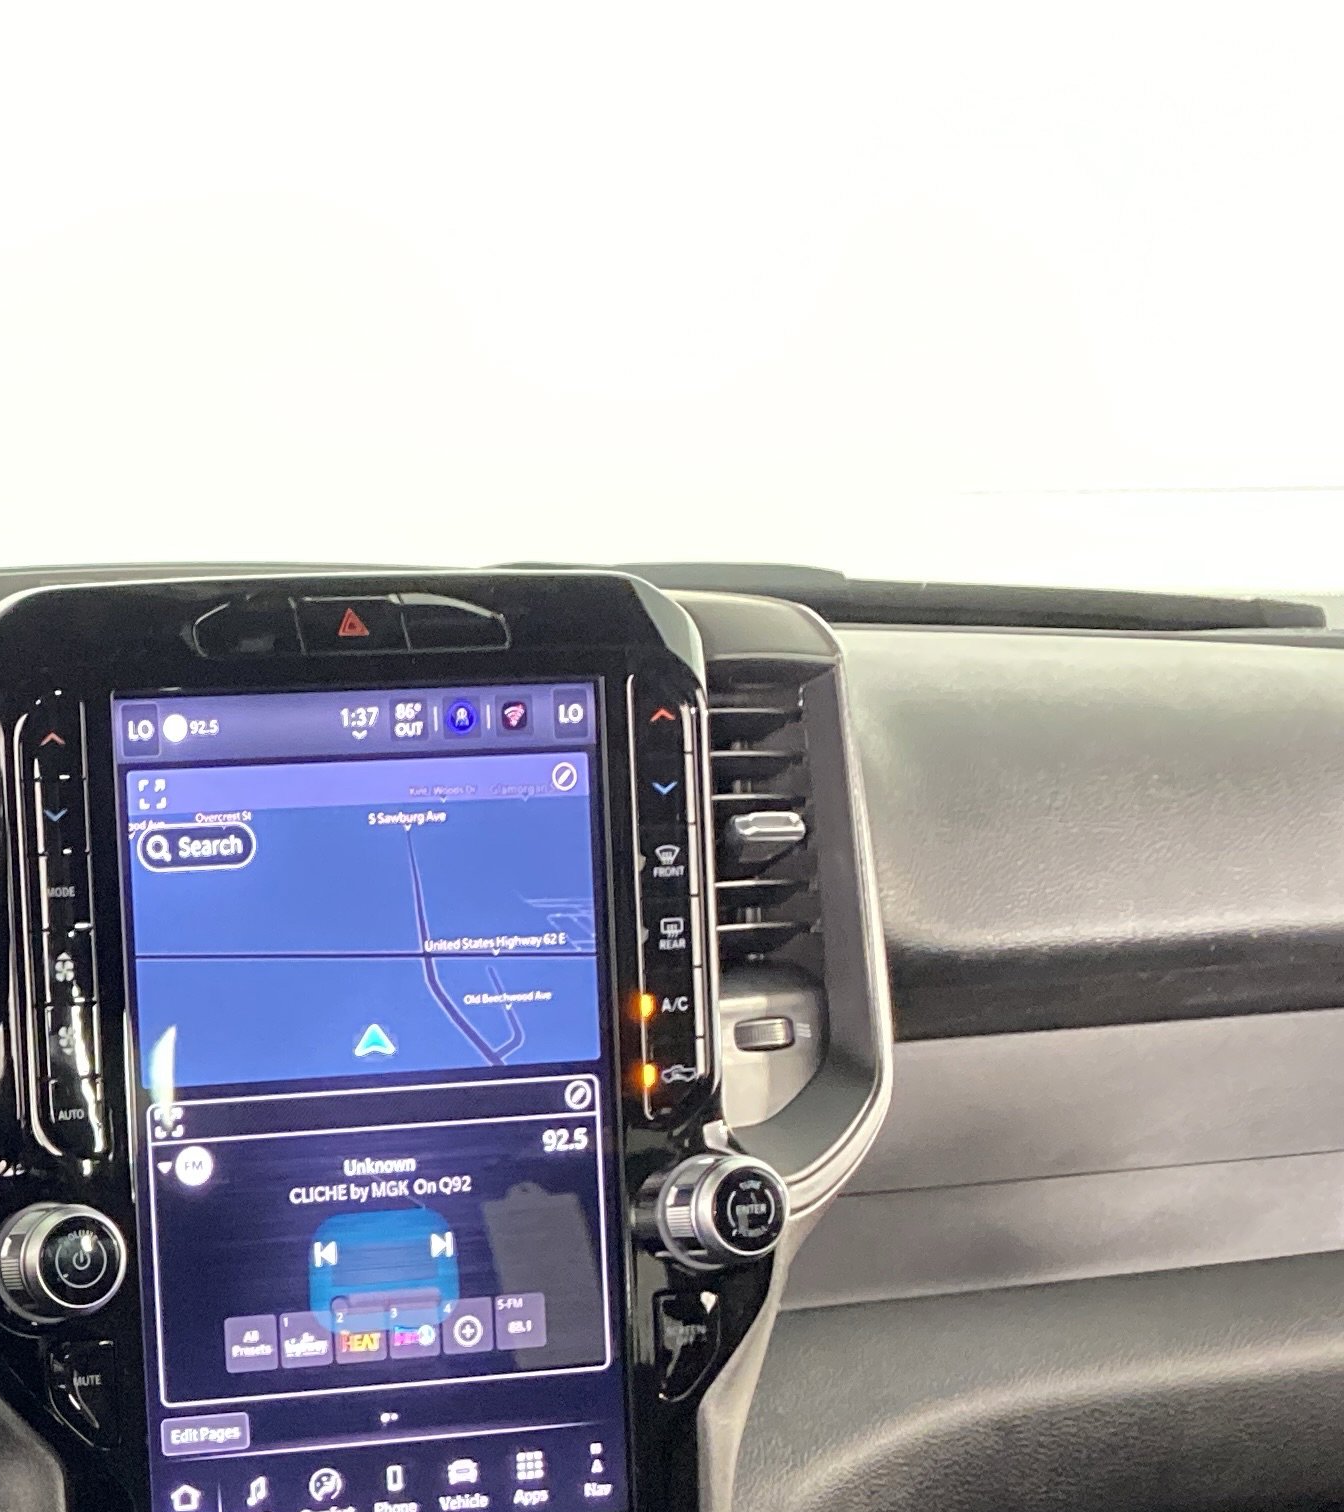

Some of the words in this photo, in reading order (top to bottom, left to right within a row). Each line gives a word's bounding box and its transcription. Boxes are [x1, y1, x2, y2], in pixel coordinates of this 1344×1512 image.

[340, 706, 379, 728] 1:37
[558, 703, 584, 725] LO
[128, 719, 155, 741] LO
[189, 719, 219, 735] 92.5
[394, 721, 423, 737] OUT
[195, 812, 241, 824] Overcrest
[368, 813, 376, 825] S
[377, 812, 426, 826] Sawburg
[426, 810, 447, 823] Ave
[178, 834, 244, 859] Search
[653, 865, 685, 878] FRONT
[47, 886, 76, 898] MODE
[424, 937, 461, 952] United
[462, 936, 495, 950] States
[496, 934, 542, 950] Highway
[543, 932, 557, 945] 62
[558, 931, 567, 944] E
[659, 938, 686, 950] REAR
[464, 994, 482, 1005] Old
[534, 990, 552, 1001] Ave
[662, 997, 689, 1012] A/C
[58, 1108, 85, 1121] AUTO
[542, 1127, 589, 1153] 92.5
[184, 1160, 203, 1171] FM
[343, 1157, 416, 1177] Unknown
[289, 1183, 348, 1204] CLICHE
[350, 1182, 370, 1202] by
[371, 1179, 409, 1198] MGK
[413, 1178, 437, 1195] On
[438, 1175, 472, 1195] Q92
[390, 1308, 398, 1319] 3
[443, 1303, 452, 1314] 4
[337, 1312, 344, 1323] 2
[341, 1332, 381, 1353] HEAT
[73, 1374, 102, 1387] MUTE
[171, 1429, 199, 1445] Edit
[200, 1426, 241, 1444] Pages
[513, 1489, 550, 1506] Apps
[583, 1482, 613, 1498] Nav
[439, 1493, 490, 1511] Vehicle
